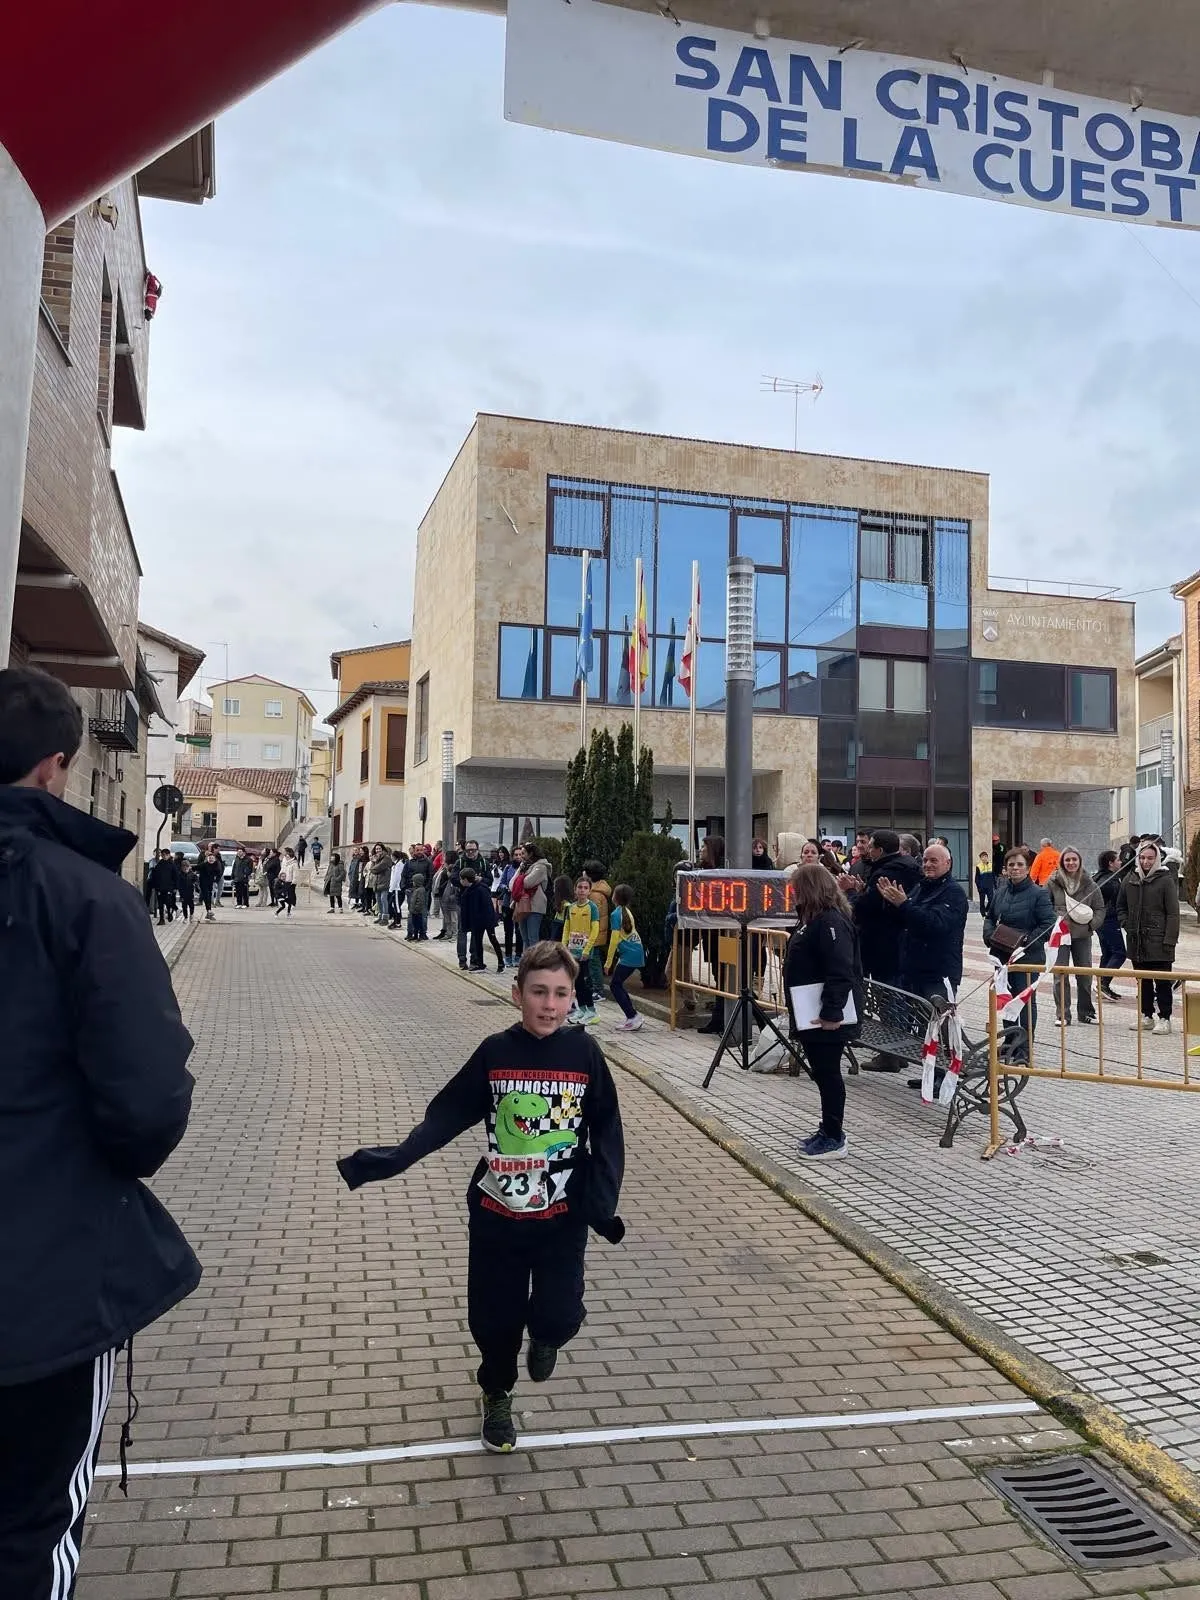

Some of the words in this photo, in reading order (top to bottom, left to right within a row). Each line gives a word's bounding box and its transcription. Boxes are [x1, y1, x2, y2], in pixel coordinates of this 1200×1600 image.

[674, 35, 842, 111] SAN
[876, 68, 1200, 174] CRISTOB
[707, 97, 808, 164] DE
[842, 118, 941, 182] LA
[1007, 614, 1102, 633] AYUNTAMIENTO
[521, 1071, 560, 1081] INCREDIBLE
[489, 1080, 587, 1097] TYRANNOSAURUS
[489, 1157, 545, 1172] dunia
[497, 1172, 530, 1197] 23
